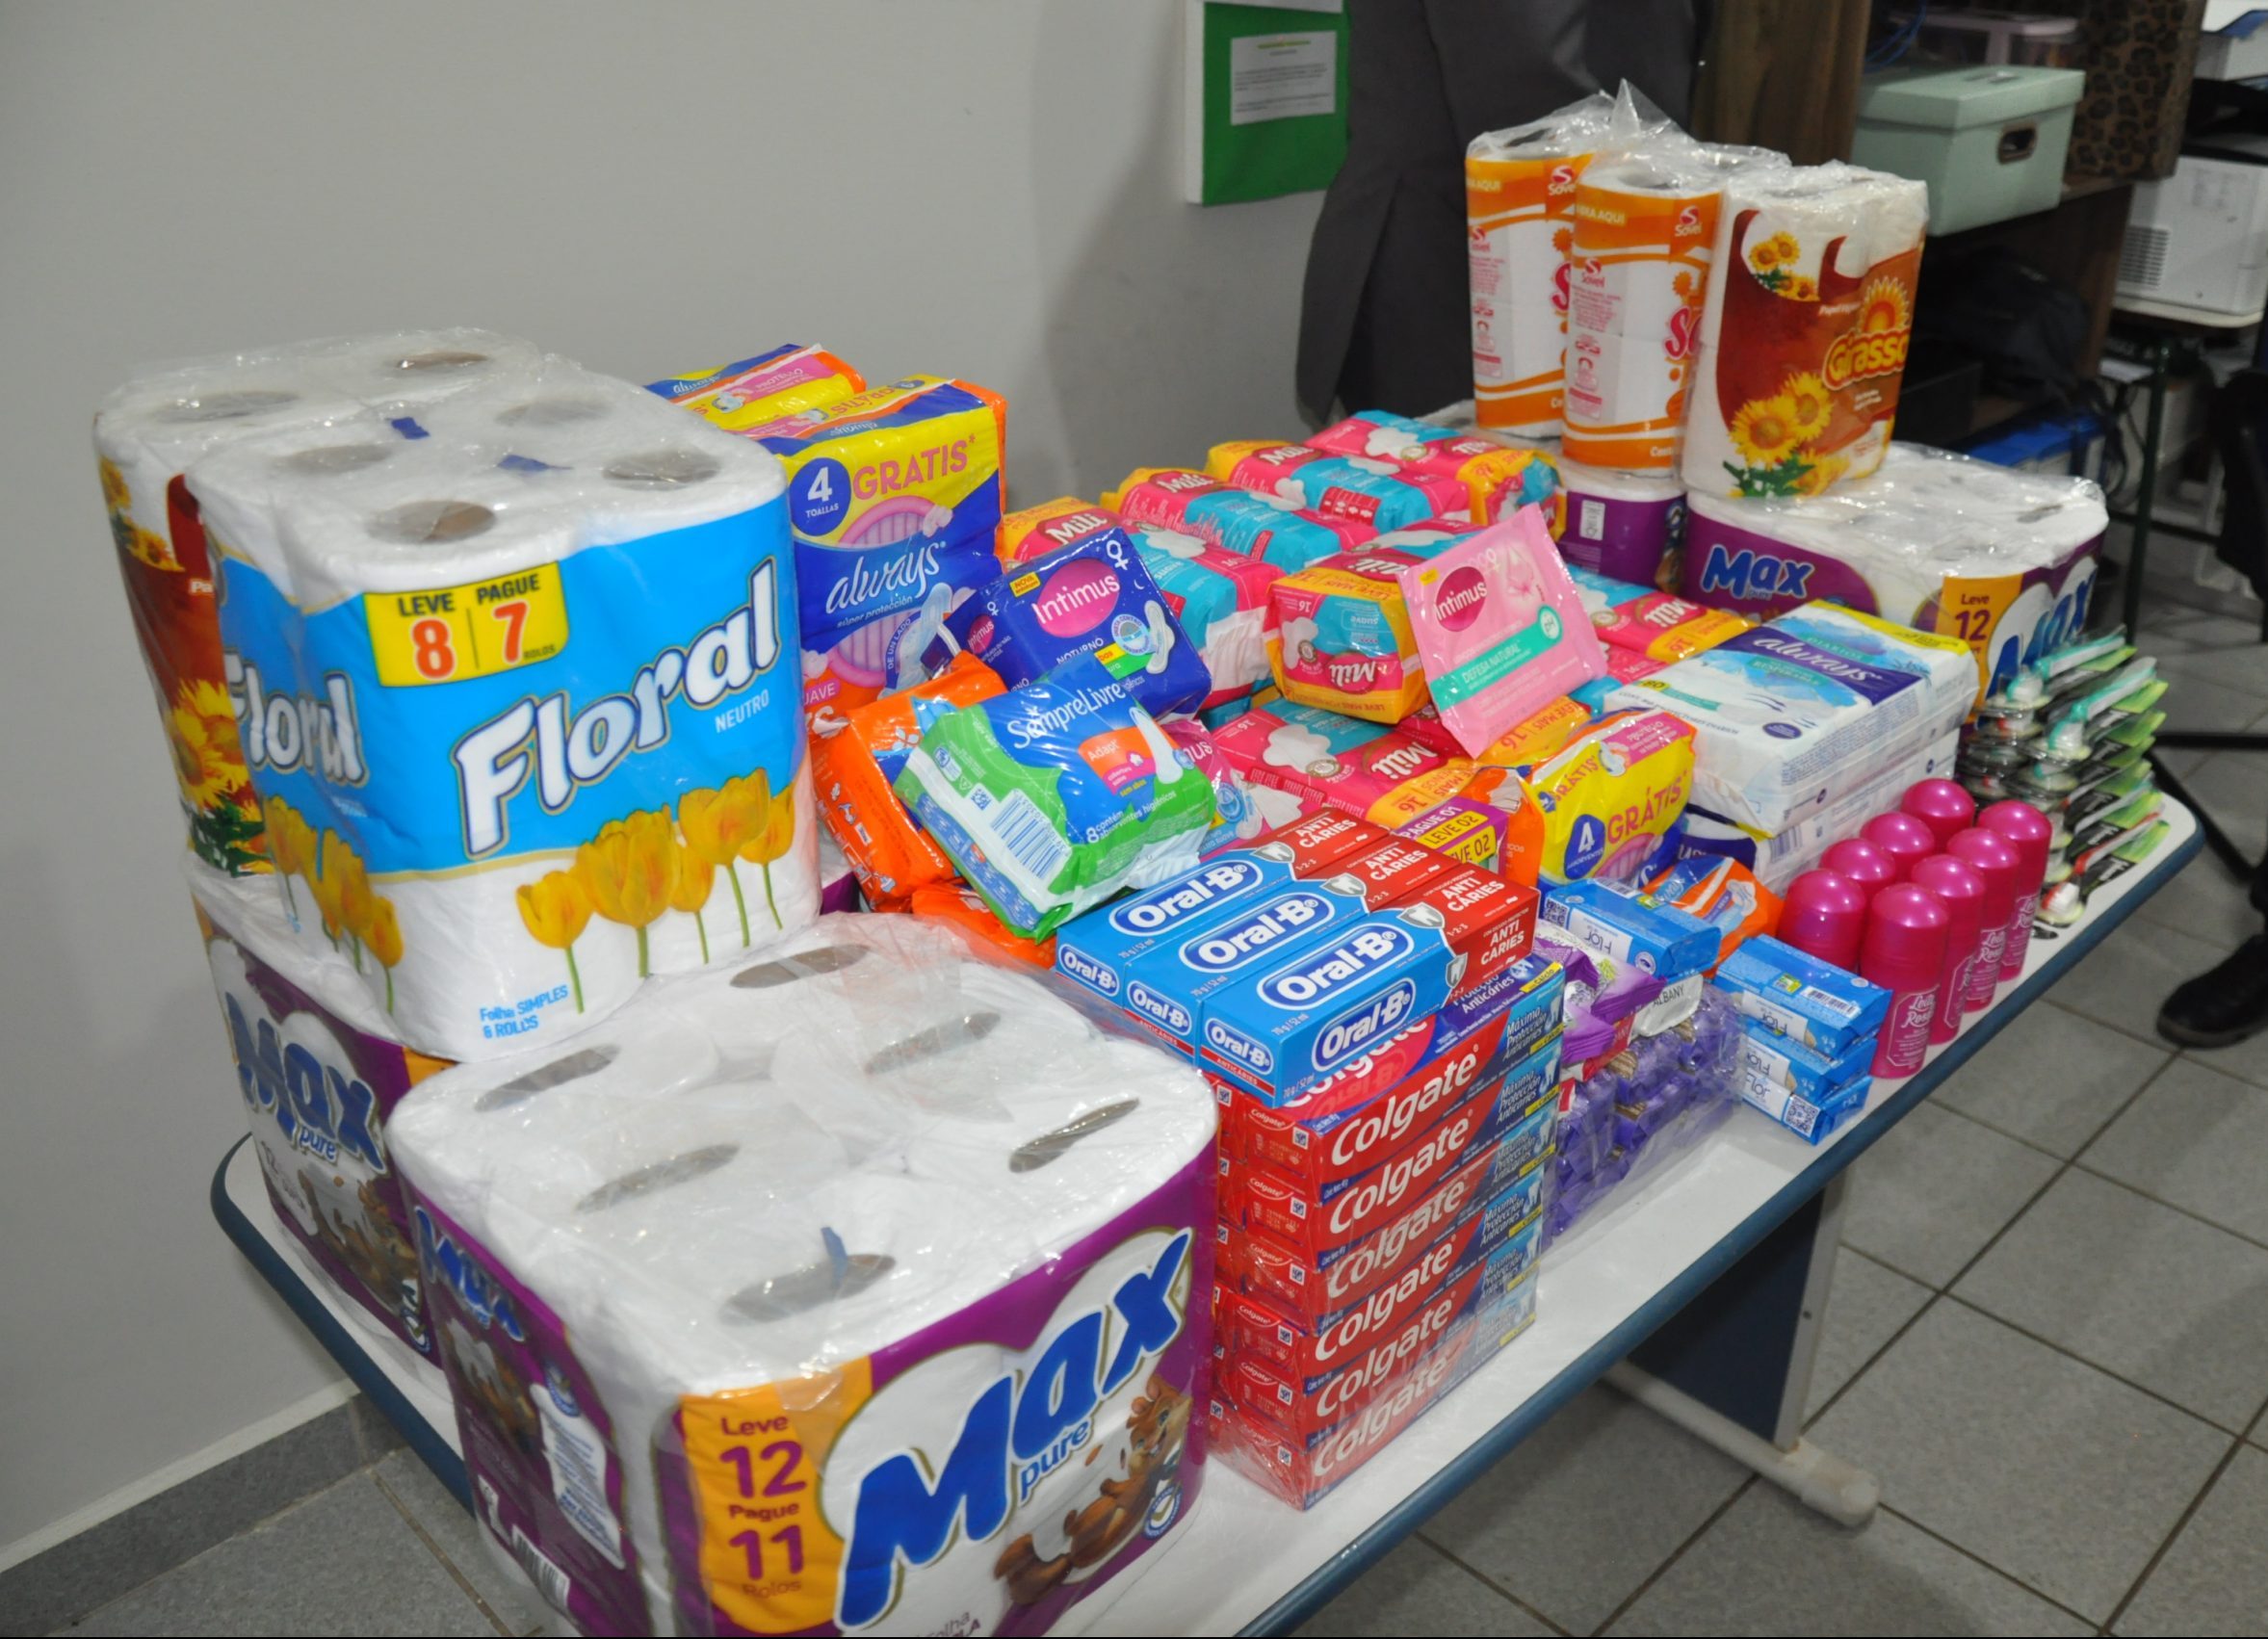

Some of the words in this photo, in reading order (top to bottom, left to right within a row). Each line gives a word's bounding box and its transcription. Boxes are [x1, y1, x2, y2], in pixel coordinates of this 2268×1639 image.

[807, 466, 834, 503] 4
[852, 438, 970, 502] GRATIS
[805, 502, 840, 520] TOALLAS
[825, 541, 942, 615] always
[1700, 542, 1815, 599] Max
[398, 590, 456, 618] LEVE
[475, 572, 541, 606] PAGUE
[1030, 575, 1121, 625] Intimus
[1433, 581, 1488, 621] Intimus
[1960, 592, 1991, 606] Leve
[411, 617, 456, 682] 8
[492, 599, 530, 664] 7
[894, 617, 912, 642] LADO
[1954, 609, 1992, 642] 12
[1328, 660, 1376, 688] Mili
[1489, 643, 1522, 672] NATURAL
[1752, 637, 1870, 682] always
[453, 556, 784, 859] Floral
[714, 689, 770, 735] NEUTRO
[1370, 741, 1440, 781] Mili
[1085, 826, 1100, 844] 8
[1095, 810, 1125, 832] contém
[1099, 809, 1144, 841] absorventes
[1142, 790, 1178, 815] higiênicos
[1295, 817, 1336, 838] ANTI
[1401, 814, 1444, 840] PAGUE
[1442, 805, 1463, 821] 01
[1423, 820, 1458, 846] LEVE
[1456, 813, 1479, 829] 02
[1605, 784, 1683, 846] GRÁTIS
[1473, 833, 1492, 854] 02
[1577, 821, 1596, 854] 4
[1365, 846, 1406, 870] ANTI
[1127, 865, 1244, 929] Oral-B
[1441, 876, 1482, 900] ANTI
[1197, 899, 1316, 964] Oral-B
[1489, 919, 1520, 948] ANTI
[1063, 951, 1114, 990] Oral-B
[1276, 930, 1396, 1002] Oral-B
[479, 1005, 516, 1022] Folha
[516, 983, 569, 1015] SIMPLES
[1133, 989, 1186, 1029] Oral-B
[1461, 975, 1516, 1014] Anticáries
[1321, 989, 1407, 1059] Oral-B
[1211, 1026, 1268, 1068] Oral-B
[1251, 1107, 1285, 1130] Colgate
[1330, 1052, 1477, 1166] Colgate
[292, 1123, 338, 1163] pure
[1249, 1177, 1283, 1198] Colgate
[1328, 1117, 1470, 1235] Colgate
[1327, 1181, 1466, 1300] Colgate
[1238, 1304, 1268, 1325] Colgate
[1315, 1239, 1454, 1363] Colgate
[1240, 1361, 1270, 1384] Colgate
[1316, 1295, 1454, 1418] Colgate
[721, 1415, 790, 1437] Leve
[834, 1226, 1194, 1629] Max
[719, 1440, 808, 1499] 12
[1018, 1417, 1092, 1508] pure
[727, 1502, 800, 1522] Pague
[727, 1523, 805, 1581] 11
